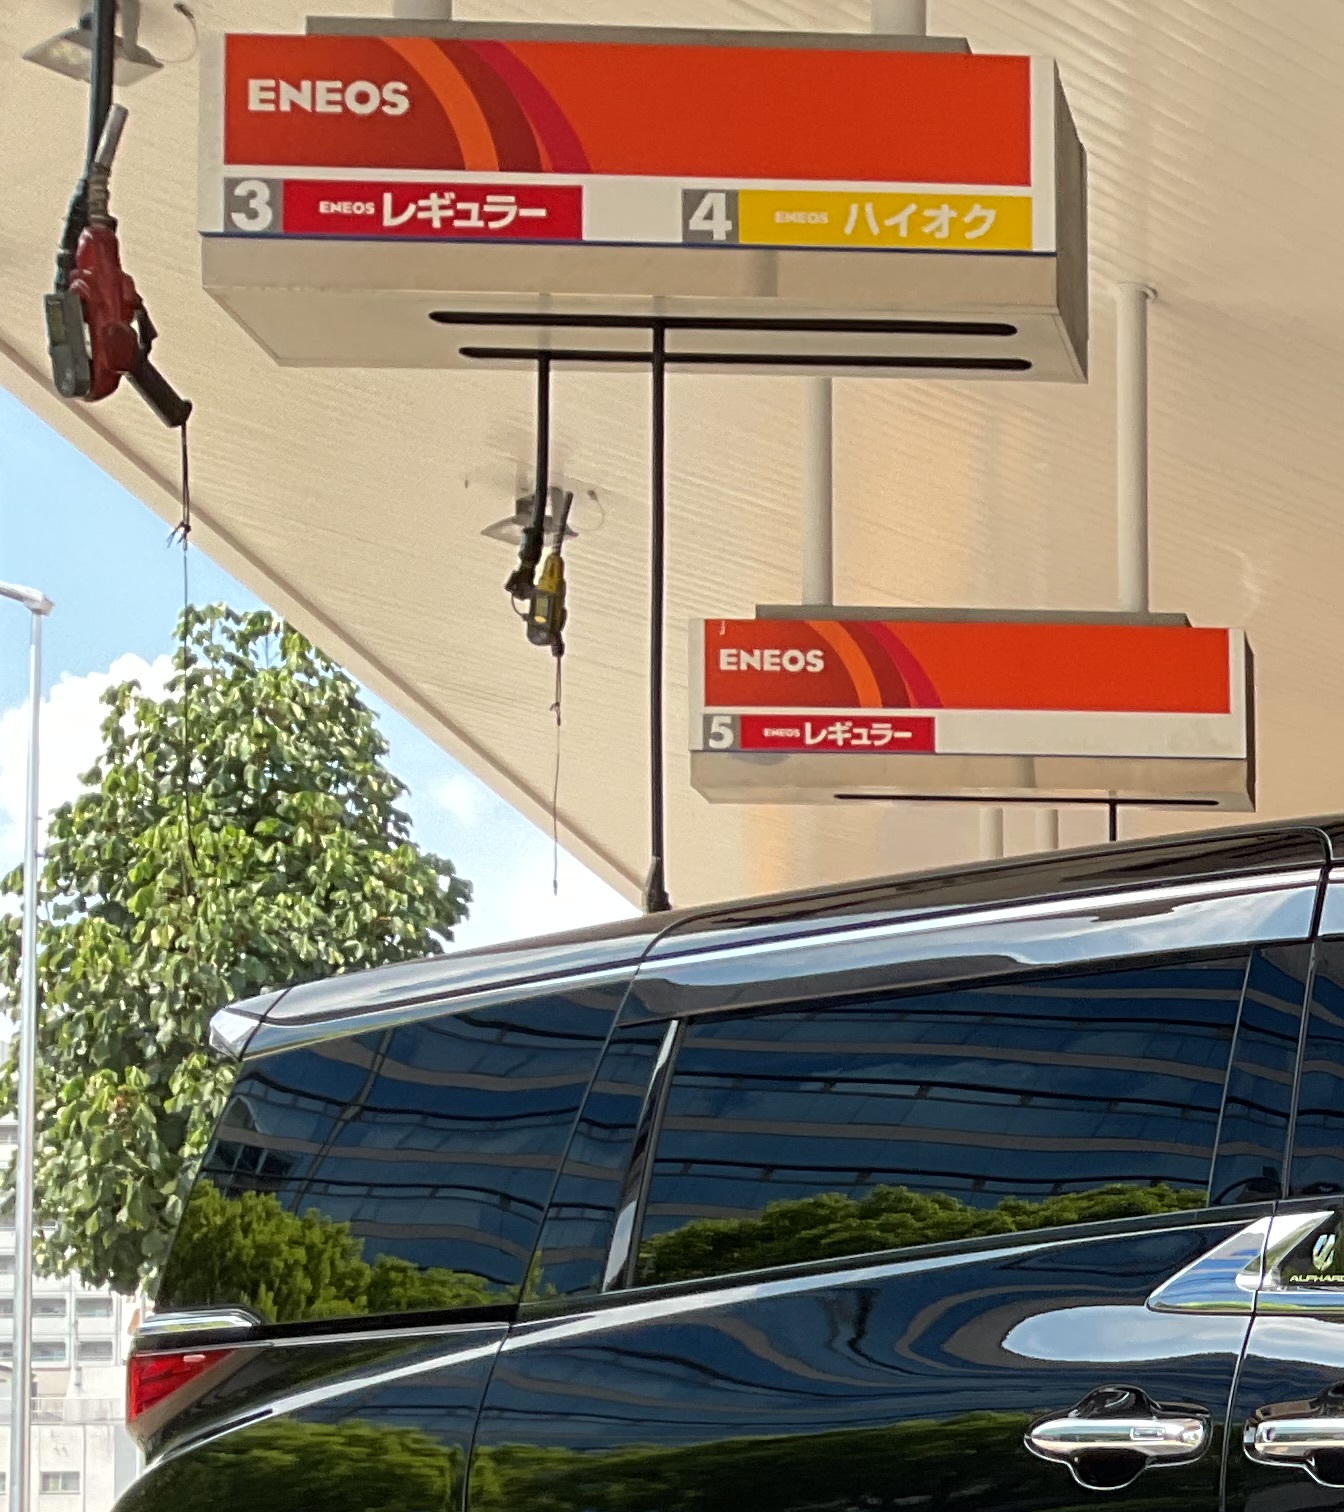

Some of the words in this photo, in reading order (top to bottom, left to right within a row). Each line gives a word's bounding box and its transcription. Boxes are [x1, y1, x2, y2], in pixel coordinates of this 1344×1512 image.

[248, 78, 410, 116] ENEOS
[231, 179, 273, 232] 3
[318, 200, 375, 216] ENEOS
[382, 191, 547, 230] レギュラー
[688, 191, 733, 241] 4
[843, 201, 997, 240] ハイオク
[719, 648, 825, 673] ENEOS
[708, 715, 735, 750] 5
[763, 727, 801, 738] ENEOS
[803, 721, 913, 747] レギュラー
